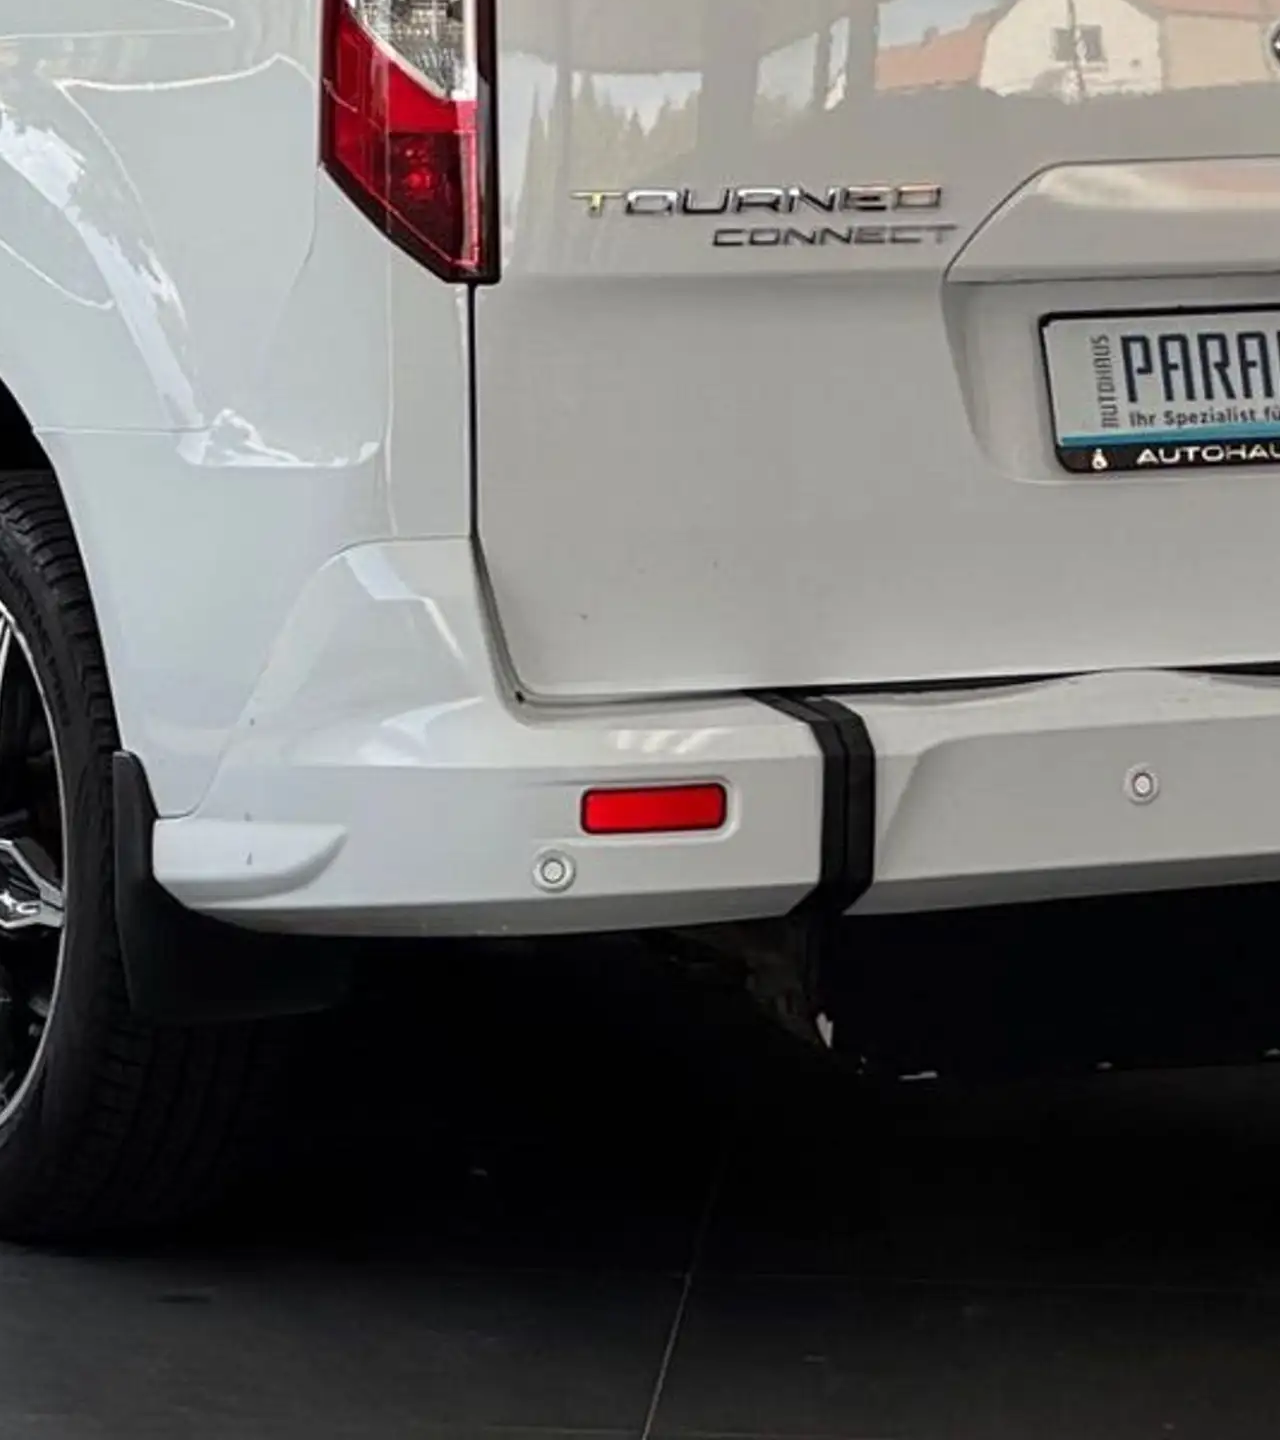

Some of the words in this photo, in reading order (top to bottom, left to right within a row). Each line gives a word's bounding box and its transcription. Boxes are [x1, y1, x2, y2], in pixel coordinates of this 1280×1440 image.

[570, 185, 942, 217] TOURNEO
[712, 223, 957, 248] CONNECT
[1092, 333, 1118, 428] AUTOHAUS
[1129, 410, 1156, 427] Ihr
[1163, 406, 1256, 428] Spezialist
